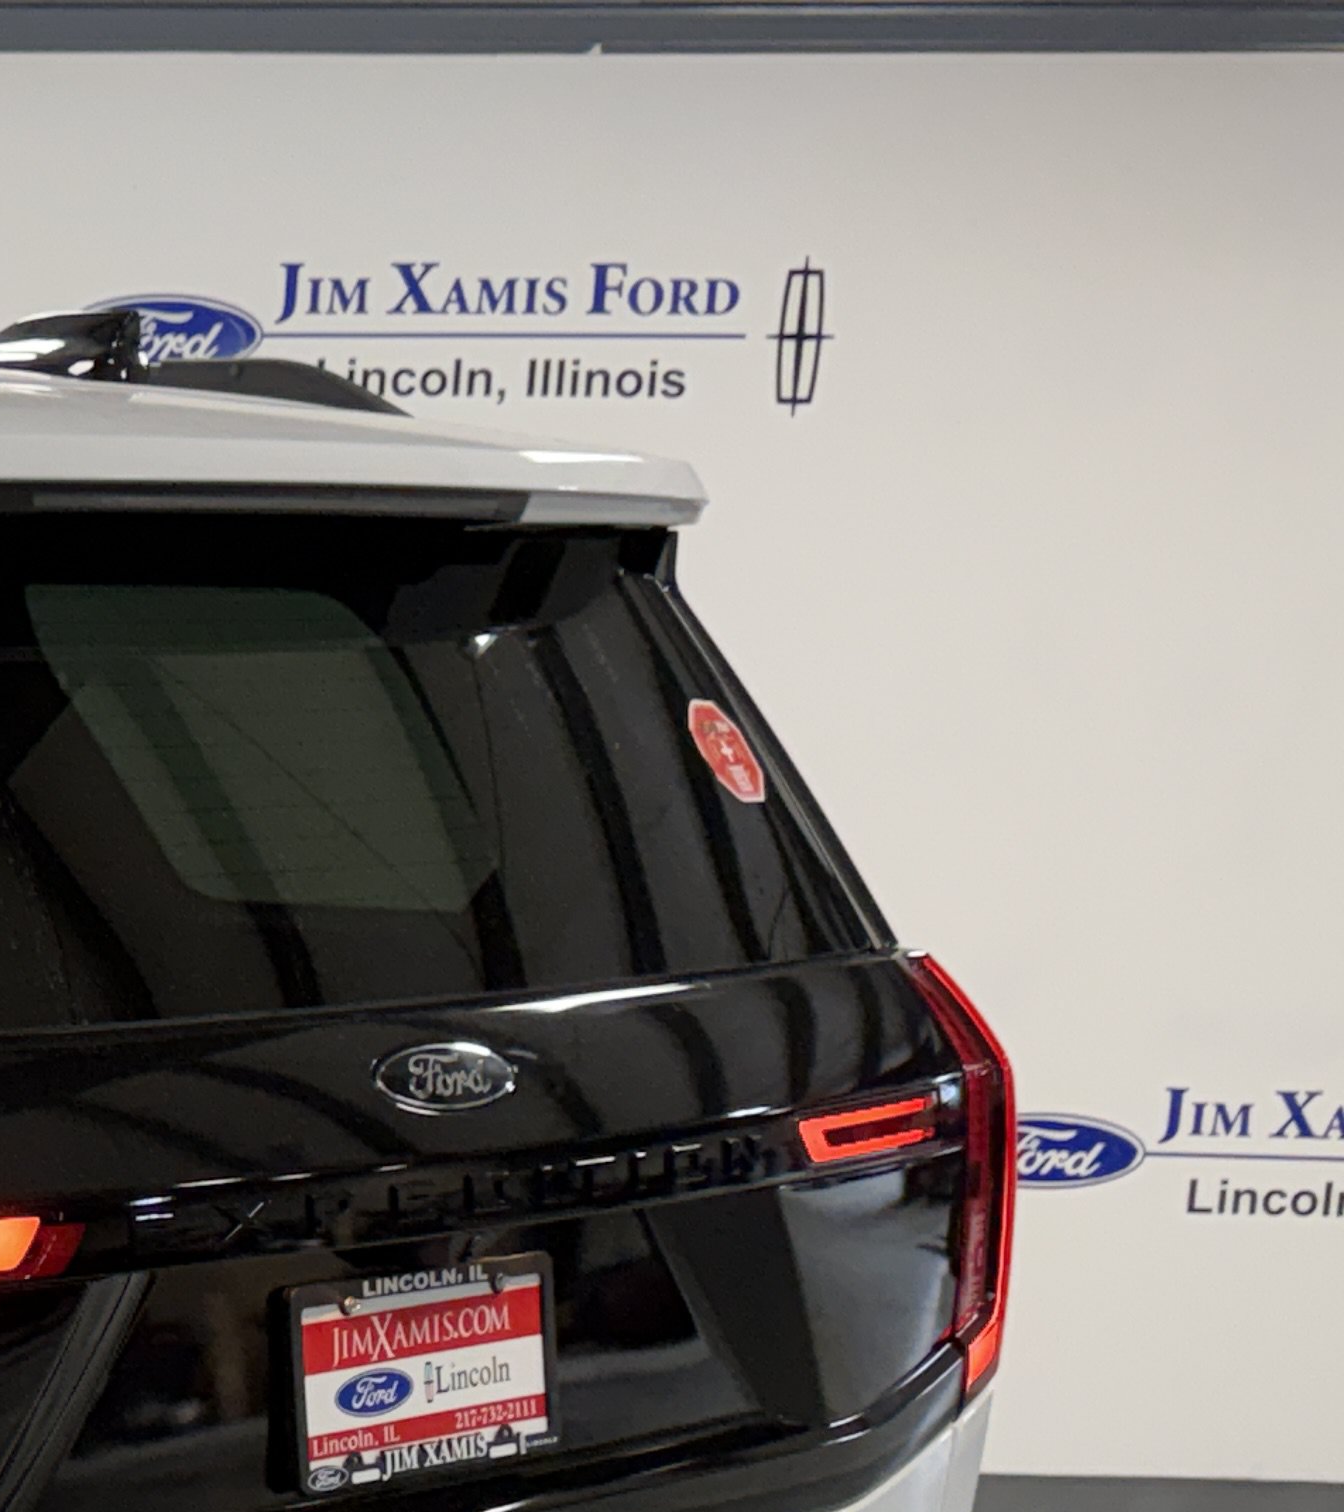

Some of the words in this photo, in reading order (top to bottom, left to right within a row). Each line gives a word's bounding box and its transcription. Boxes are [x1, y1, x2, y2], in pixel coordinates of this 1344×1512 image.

[275, 263, 370, 324] JIM
[389, 263, 568, 319] XAMIS
[589, 263, 741, 318] FORD
[317, 357, 506, 405] incoln,
[525, 357, 688, 400] Illinois
[407, 1051, 493, 1098] Ford
[1158, 1086, 1255, 1144] JIM
[469, 1264, 488, 1281] IL
[434, 1355, 511, 1395] Lincoln
[381, 1448, 418, 1482] JIM
[423, 1432, 489, 1468] XAMIS
[383, 1425, 400, 1444] IL
